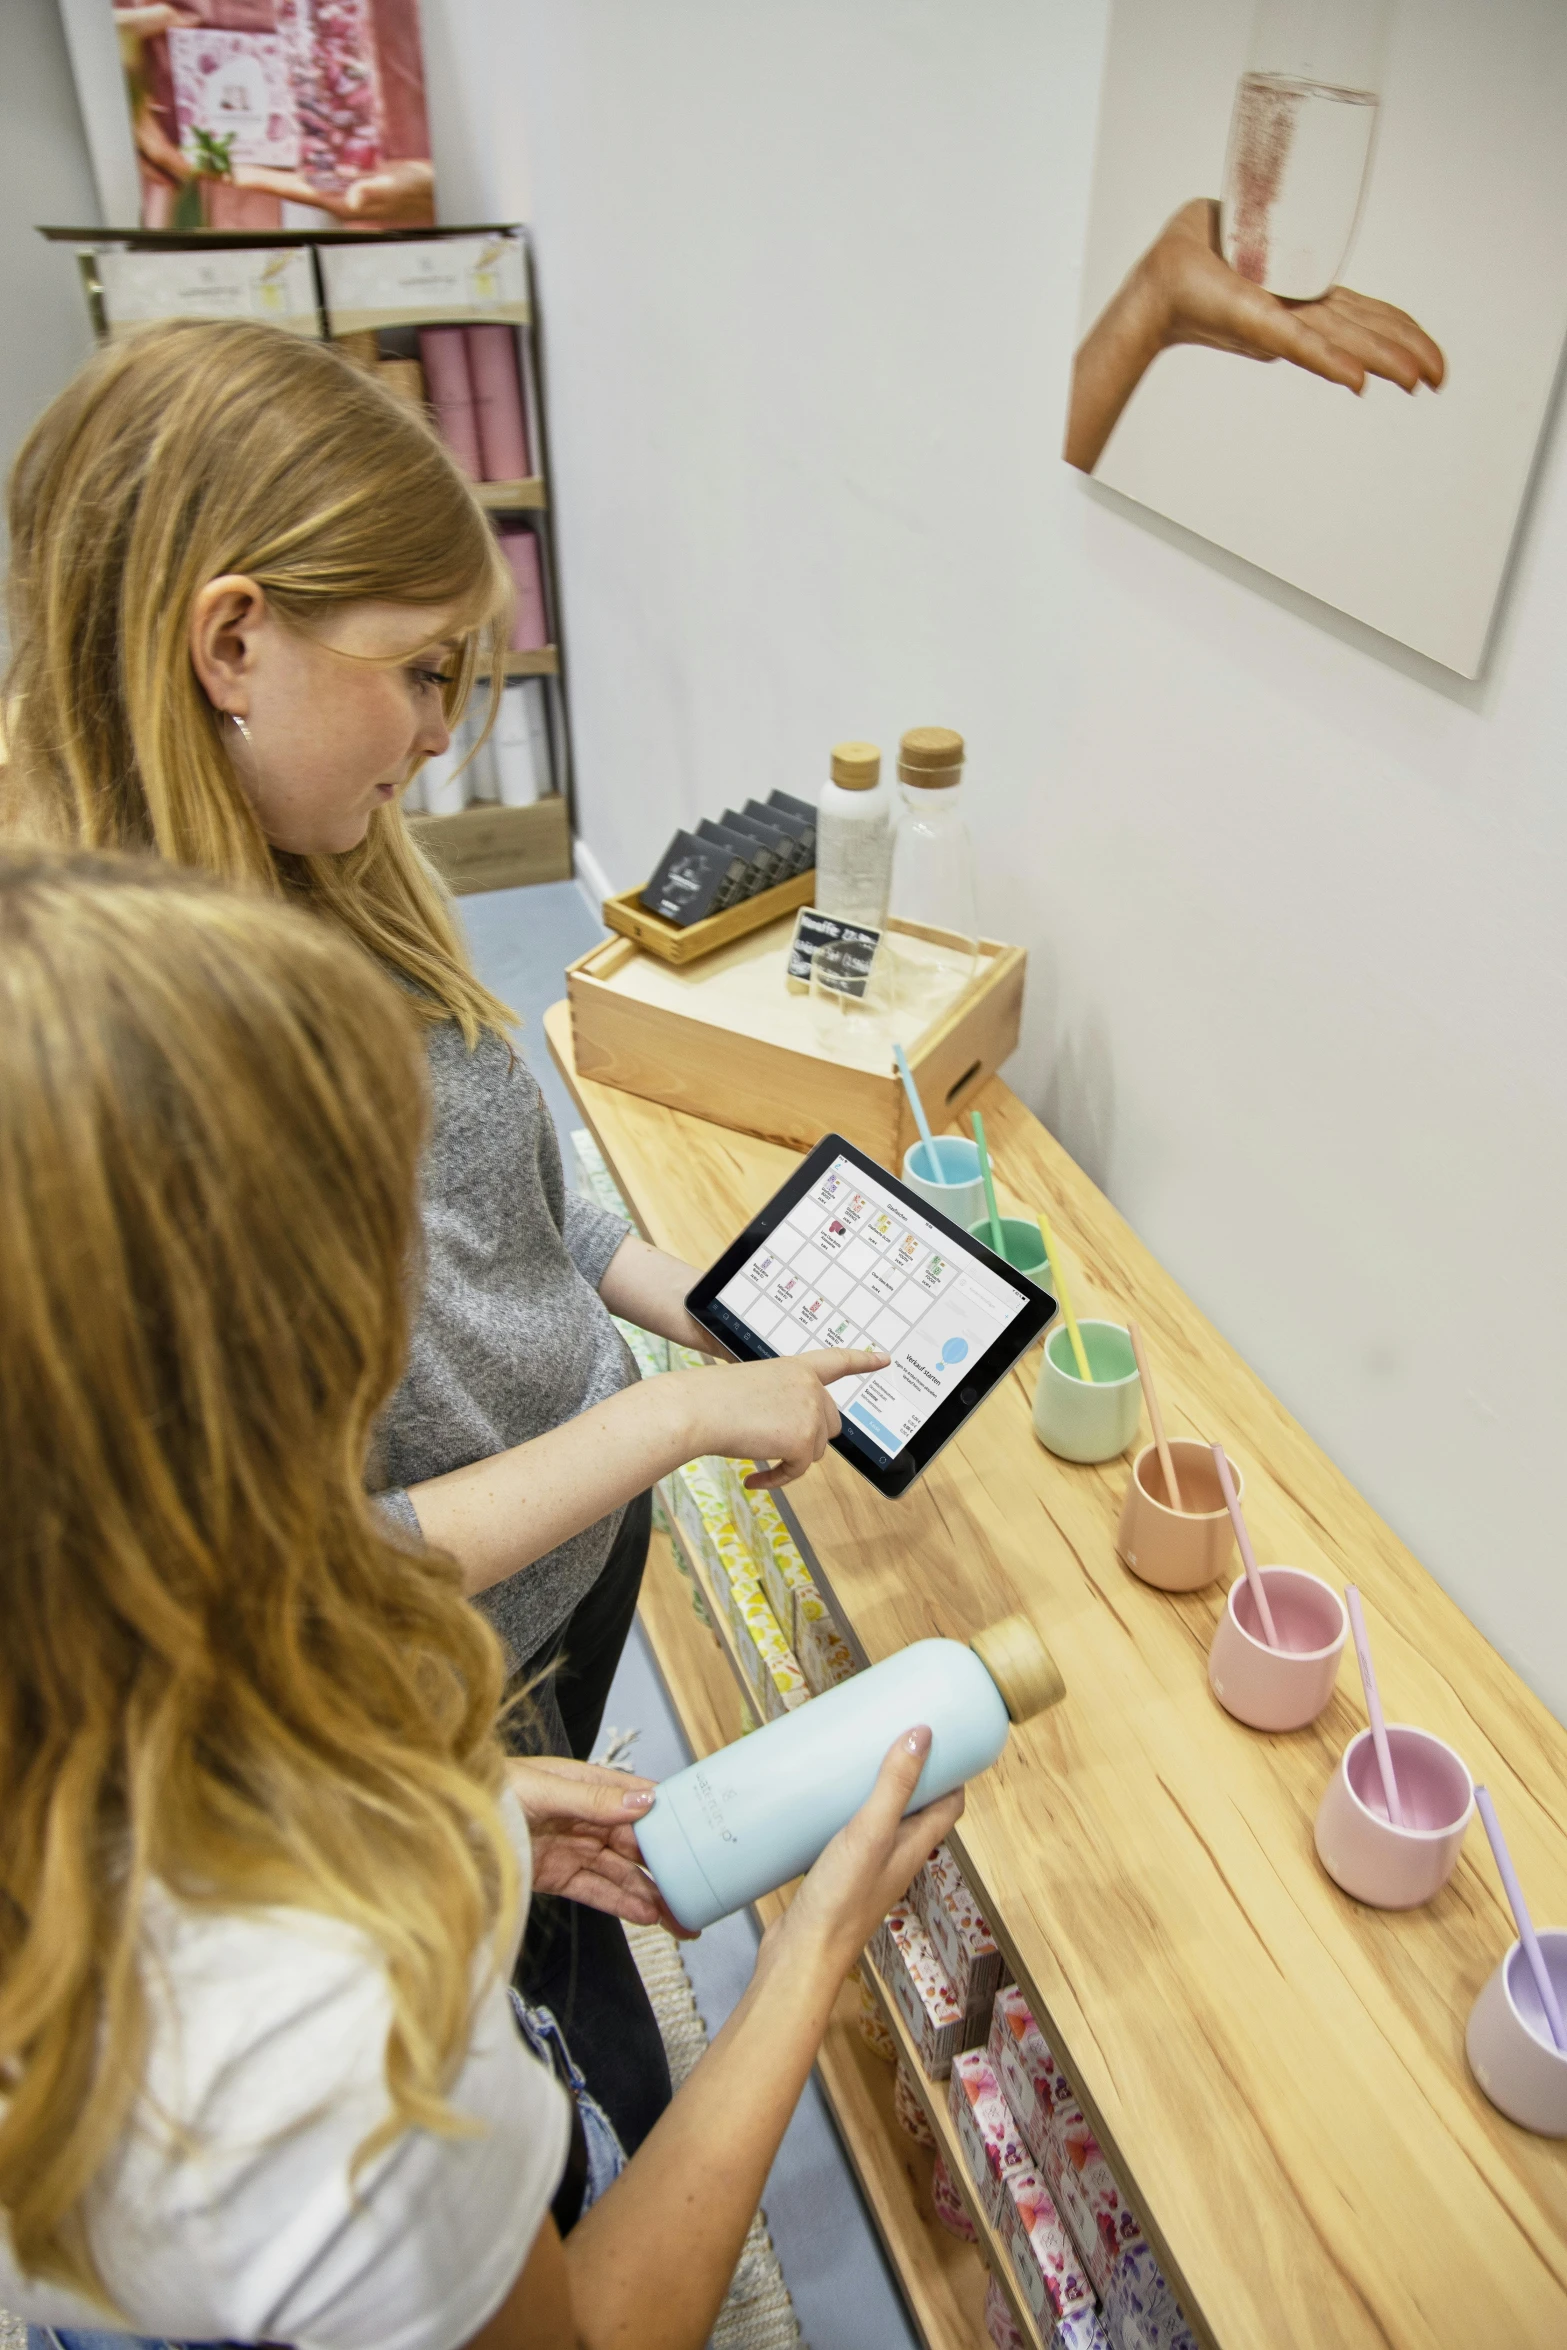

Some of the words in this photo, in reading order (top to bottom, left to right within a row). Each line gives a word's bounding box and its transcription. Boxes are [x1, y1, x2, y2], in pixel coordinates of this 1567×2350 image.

[906, 1353, 926, 1372] Verkauf
[923, 1369, 941, 1387] starten
[907, 1371, 917, 1380] Artikel
[902, 1374, 915, 1385] Verkauf
[864, 1388, 879, 1402] Summe
[847, 1427, 855, 1436] City
[869, 1421, 881, 1432] Kasse
